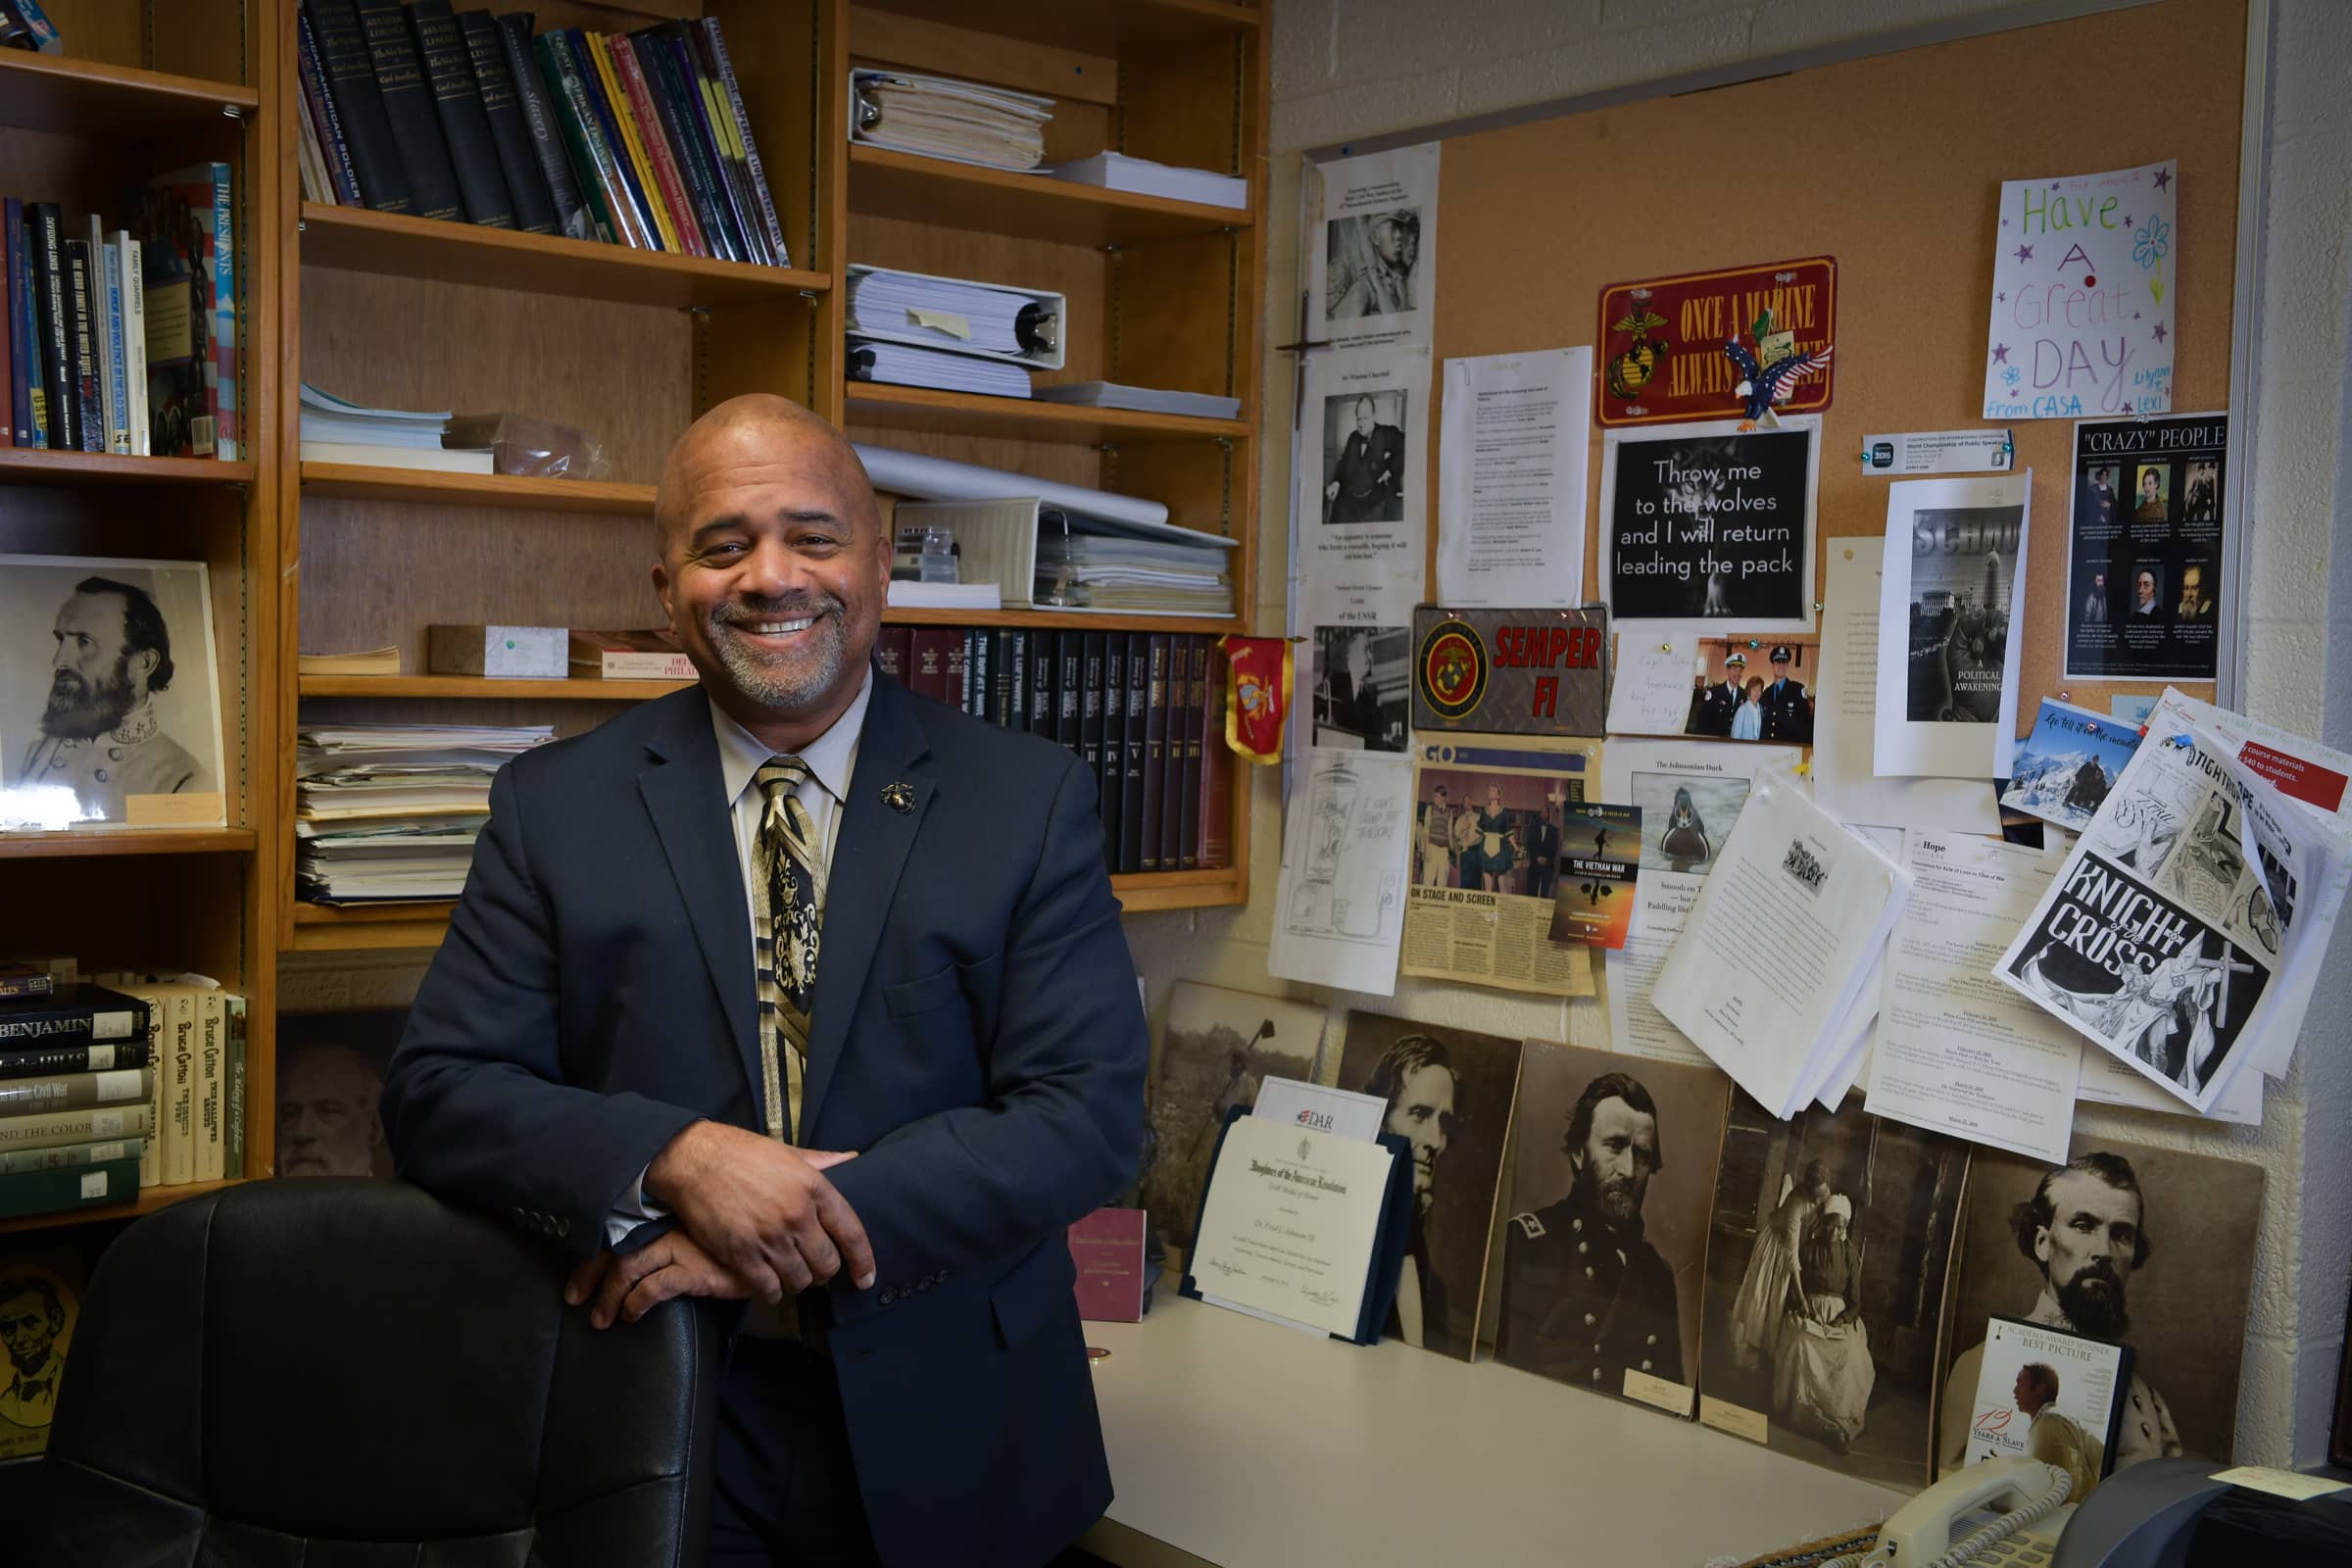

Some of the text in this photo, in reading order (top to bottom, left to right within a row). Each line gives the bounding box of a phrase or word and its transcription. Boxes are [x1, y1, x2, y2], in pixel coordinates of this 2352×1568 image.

[339, 143, 361, 199] SOLDIER
[218, 182, 230, 201] THE
[2024, 187, 2119, 235] Have
[45, 217, 59, 270] DIVIDING LINES
[2057, 242, 2095, 272] A
[131, 250, 142, 315] FAMILY QUARRELS
[74, 290, 86, 312] FAMILY
[1680, 284, 1817, 343] ONCE A MARINE
[2014, 282, 2134, 329] Great
[76, 321, 88, 333] THE
[79, 356, 92, 376] STATES
[1668, 351, 1734, 398] ALWAYS
[114, 375, 123, 391] THE
[32, 395, 48, 430] USED
[116, 405, 125, 430] SOUTH
[1985, 394, 2083, 418] from CASA
[2083, 424, 2226, 452] "CRAZY" PEOPLE
[1652, 459, 1762, 484] Throw me
[1636, 486, 1778, 514] to the wolves
[1620, 516, 1790, 545] and I will return
[1617, 546, 1793, 581] leading the pack
[963, 637, 972, 657] THE
[1493, 626, 1601, 669] SEMPER
[975, 635, 988, 716] THE RAF AT WAR
[1957, 669, 2001, 680] POLITICAL
[1978, 659, 1984, 668] A
[1532, 676, 1559, 717] FI
[1953, 681, 2002, 693] AWAKENING
[2059, 716, 2075, 730] tell
[2075, 720, 2083, 735] it
[1106, 751, 1118, 762] IV
[1656, 760, 1667, 769] The
[1705, 763, 1723, 772] Duck
[2247, 746, 2305, 773] course materials
[2265, 765, 2298, 783] students.
[1923, 840, 1946, 854] Hope
[1573, 859, 1625, 873] THE VIETNAM WAR
[1410, 888, 1496, 906] ON STAGE AND SCREEN
[1647, 901, 1677, 913] Paddling
[2063, 857, 2189, 956] KNIGHT
[2047, 902, 2157, 976] CROSS
[0, 1017, 93, 1039] BENJAMIN
[175, 1020, 192, 1084] Bruce Catton
[204, 1016, 220, 1079] Bruce Catton
[33, 1083, 52, 1099] Civil
[52, 1081, 69, 1098] War
[23, 1122, 93, 1138] THE COLOR
[1307, 1111, 1334, 1130] DAR
[2006, 1323, 2044, 1342] ACADEMY
[2075, 1341, 2110, 1356] WINNER
[2022, 1339, 2094, 1362] BEST PICTURE
[1975, 1408, 2013, 1437] 12
